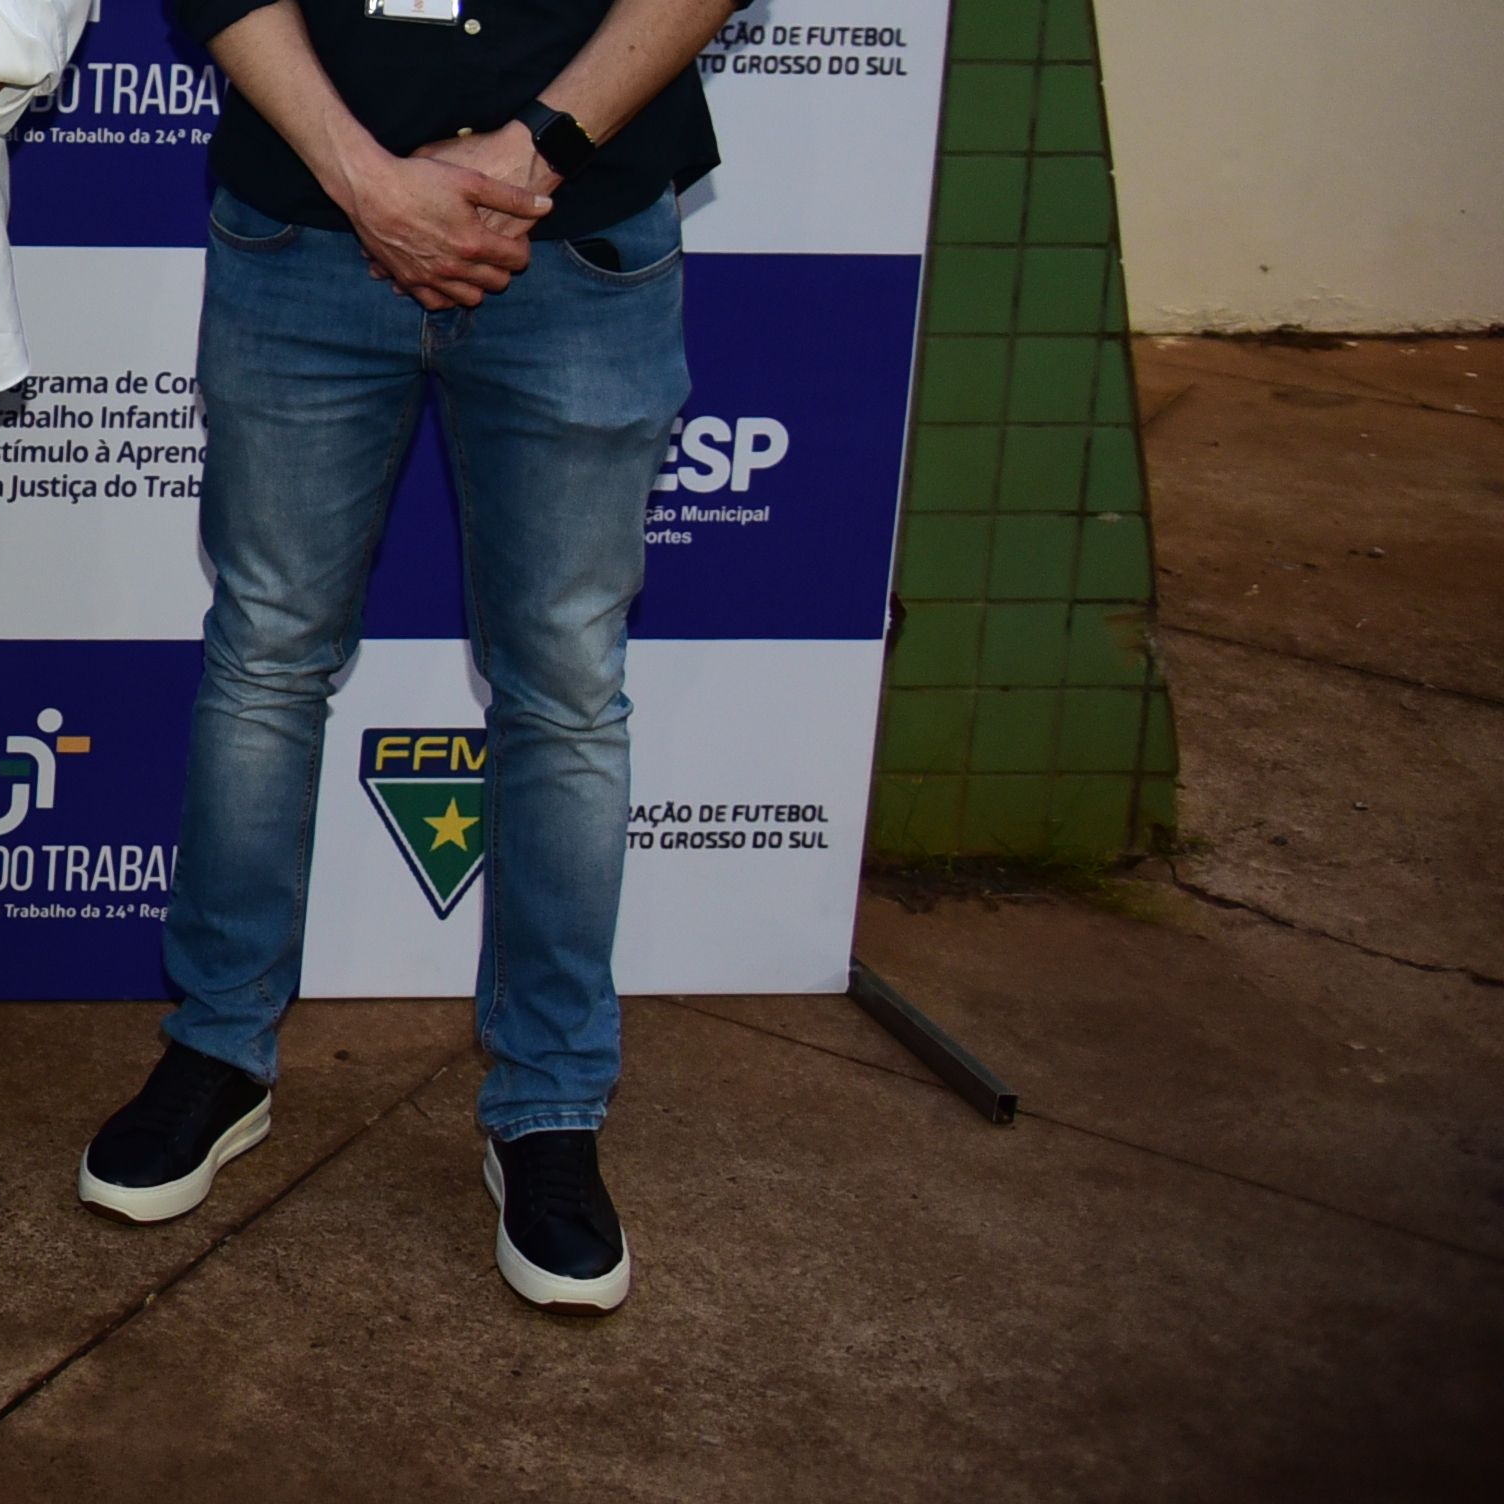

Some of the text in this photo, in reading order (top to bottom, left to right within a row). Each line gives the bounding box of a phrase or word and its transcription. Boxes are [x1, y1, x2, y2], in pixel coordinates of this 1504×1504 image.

[773, 26, 801, 45] DE
[807, 27, 907, 47] FUTEBOL
[699, 55, 907, 76] TO GROSSO DO SUL
[88, 63, 229, 115] TRABA
[24, 128, 45, 142] do
[50, 128, 125, 143] Trabalho
[129, 128, 150, 144] da
[116, 371, 147, 393] de
[101, 405, 195, 428] Infantil
[95, 439, 109, 463] à
[7, 474, 202, 504] Justiça do Trab
[681, 506, 769, 525] Municipal
[645, 529, 692, 544] ortes
[376, 737, 486, 770] FFM
[699, 805, 726, 822] DE
[732, 805, 828, 822] FUTEBOL
[627, 831, 828, 849] TO GROSSO DO SUL
[42, 845, 177, 891] TRABA
[5, 904, 76, 918] Trabalho
[81, 905, 100, 918] da
